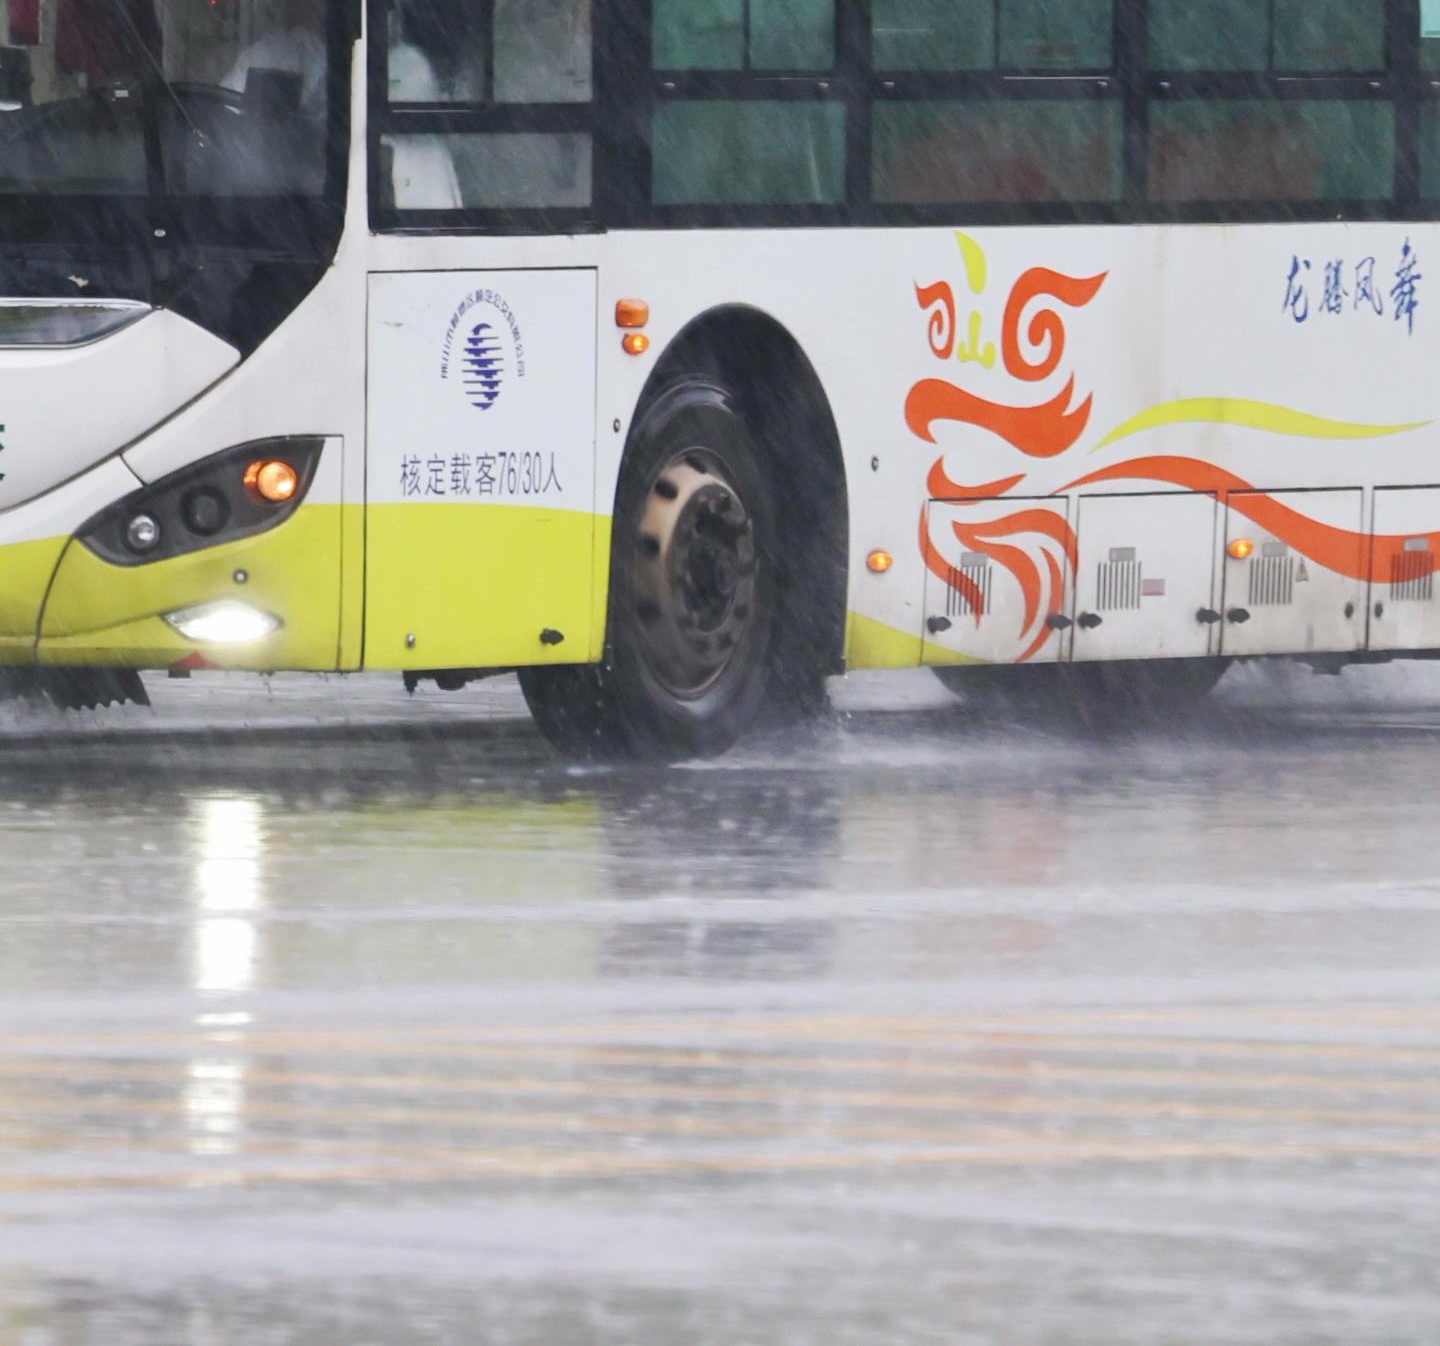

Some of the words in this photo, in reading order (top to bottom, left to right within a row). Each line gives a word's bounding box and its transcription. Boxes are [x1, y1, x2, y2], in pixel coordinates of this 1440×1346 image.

[400, 451, 563, 497] 核定载客76/30人
